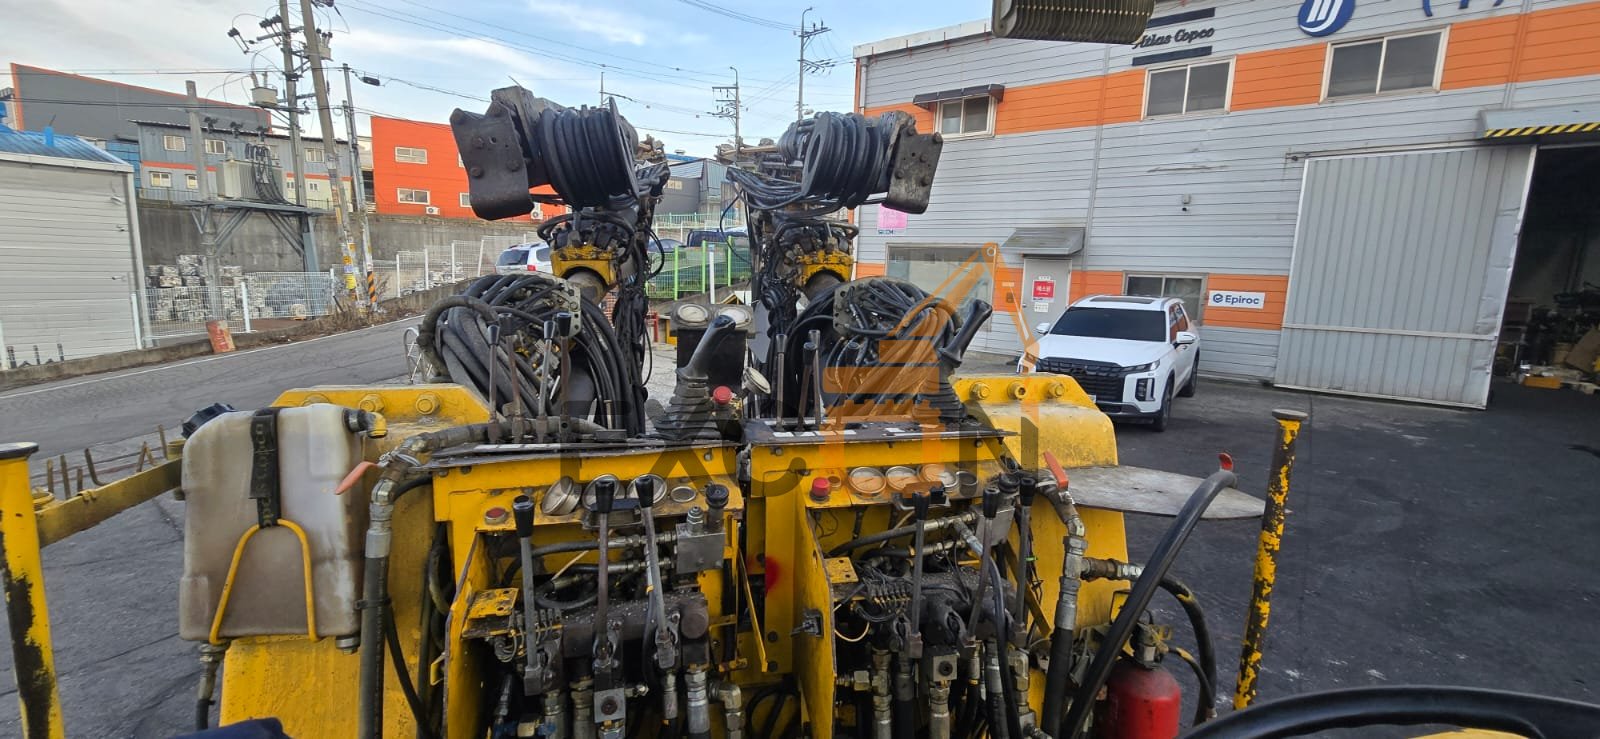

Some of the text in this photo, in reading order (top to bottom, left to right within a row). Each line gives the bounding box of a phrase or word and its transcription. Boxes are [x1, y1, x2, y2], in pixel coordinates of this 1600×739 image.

[1131, 28, 1215, 50] Atlas Copco
[1225, 294, 1260, 305] Epiroc
